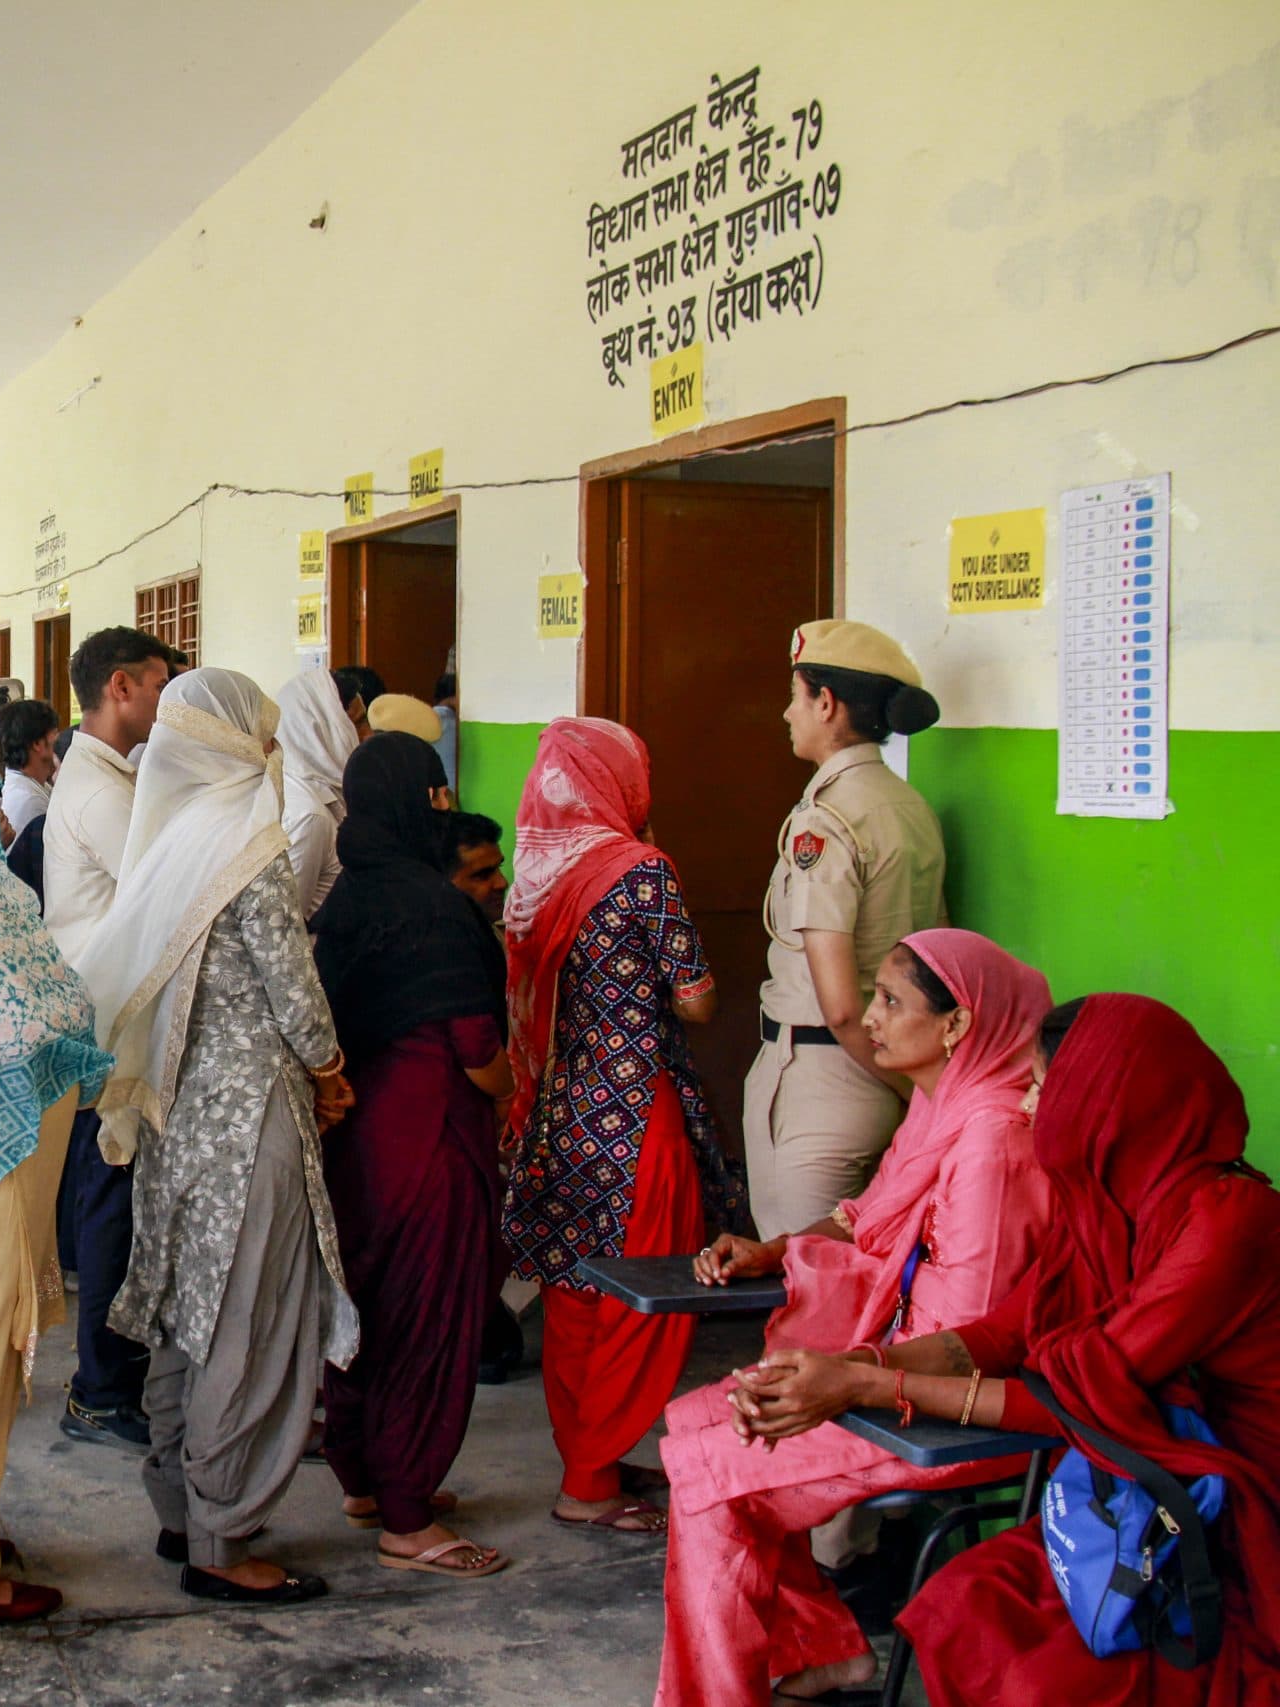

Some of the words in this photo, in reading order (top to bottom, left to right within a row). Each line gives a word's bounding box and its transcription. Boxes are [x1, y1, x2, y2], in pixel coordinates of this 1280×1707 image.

[621, 104, 697, 178] मतदान
[586, 190, 650, 258] विधान
[651, 169, 690, 226] सभा
[694, 144, 730, 206] क्षेत्र
[586, 259, 630, 324] लोक
[634, 240, 677, 297] सभा
[681, 213, 719, 278] क्षेत्र
[602, 325, 634, 388] बूथ
[653, 371, 695, 422] ENTRY
[410, 467, 439, 499] FEMALE
[349, 490, 366, 516] MALE
[961, 556, 979, 577] YOU
[981, 554, 997, 575] ARE
[999, 552, 1030, 573] UNDER
[951, 581, 973, 602] CCTV
[975, 577, 1040, 601] SURVEILLANCE
[298, 610, 317, 636] ENTRY
[541, 595, 577, 626] FEMALE
